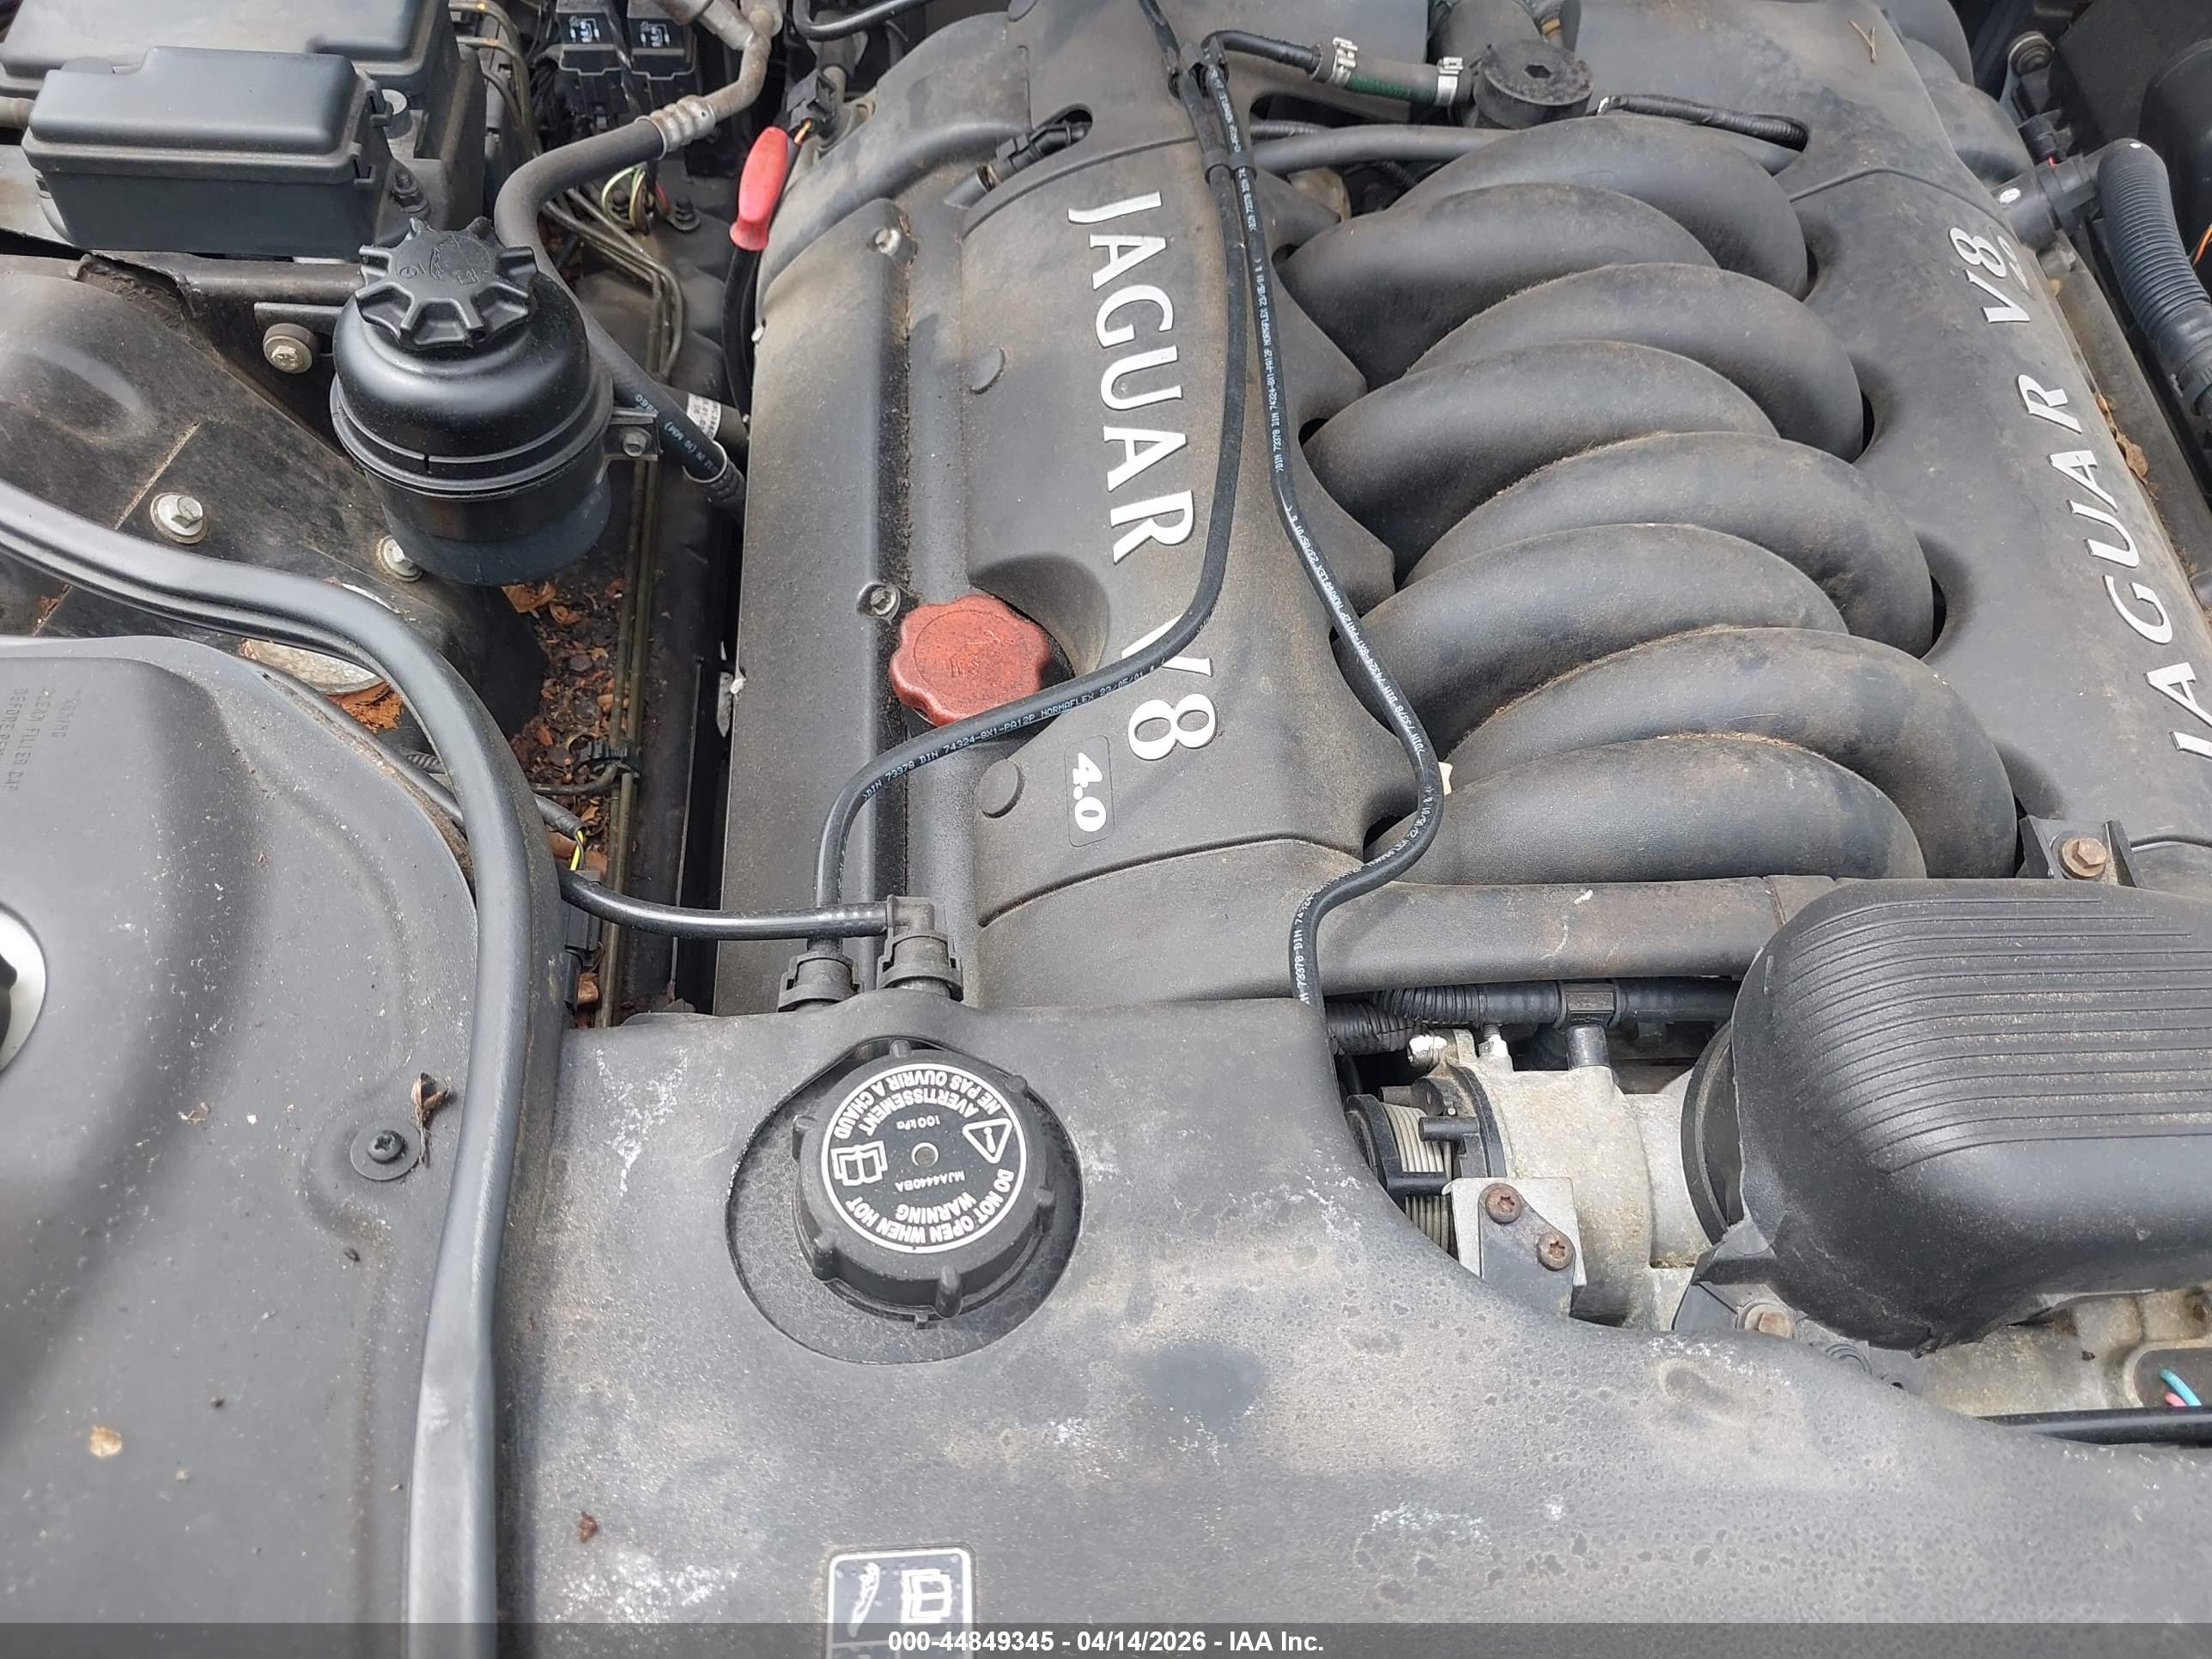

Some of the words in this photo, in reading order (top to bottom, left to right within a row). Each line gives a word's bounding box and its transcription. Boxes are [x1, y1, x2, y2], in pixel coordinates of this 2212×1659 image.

[1948, 227, 2031, 323] V8
[1067, 191, 1195, 564] JAGUAR
[665, 422, 685, 441] MM)
[1271, 412, 1280, 427] DIN
[1272, 429, 1282, 453] 73378
[1121, 613, 1218, 761] V8
[1382, 684, 1398, 703] DIN
[884, 761, 915, 782] 73378
[919, 751, 939, 765] DIN
[1041, 692, 1095, 716] NORMAFLEX
[1073, 752, 1107, 832] 4.0
[1293, 929, 1304, 950] DIN
[1294, 955, 1310, 992] 73378
[871, 1081, 887, 1097] A
[885, 1070, 948, 1091] OUVRIR
[949, 1075, 982, 1100] PAS
[834, 1091, 875, 1139] CHAUD
[859, 1087, 979, 1137] AVERTISSEMENT
[977, 1095, 1001, 1115] NE
[896, 1118, 917, 1131] kPa
[918, 1115, 941, 1128] 100
[895, 1170, 965, 1193] MJA4440BA
[994, 1169, 1015, 1193] DO
[845, 1196, 880, 1228] HOT
[894, 1191, 977, 1224] WARNING
[974, 1190, 1004, 1224] NOT
[875, 1217, 927, 1244] WHEN
[929, 1215, 975, 1243] OPEN
